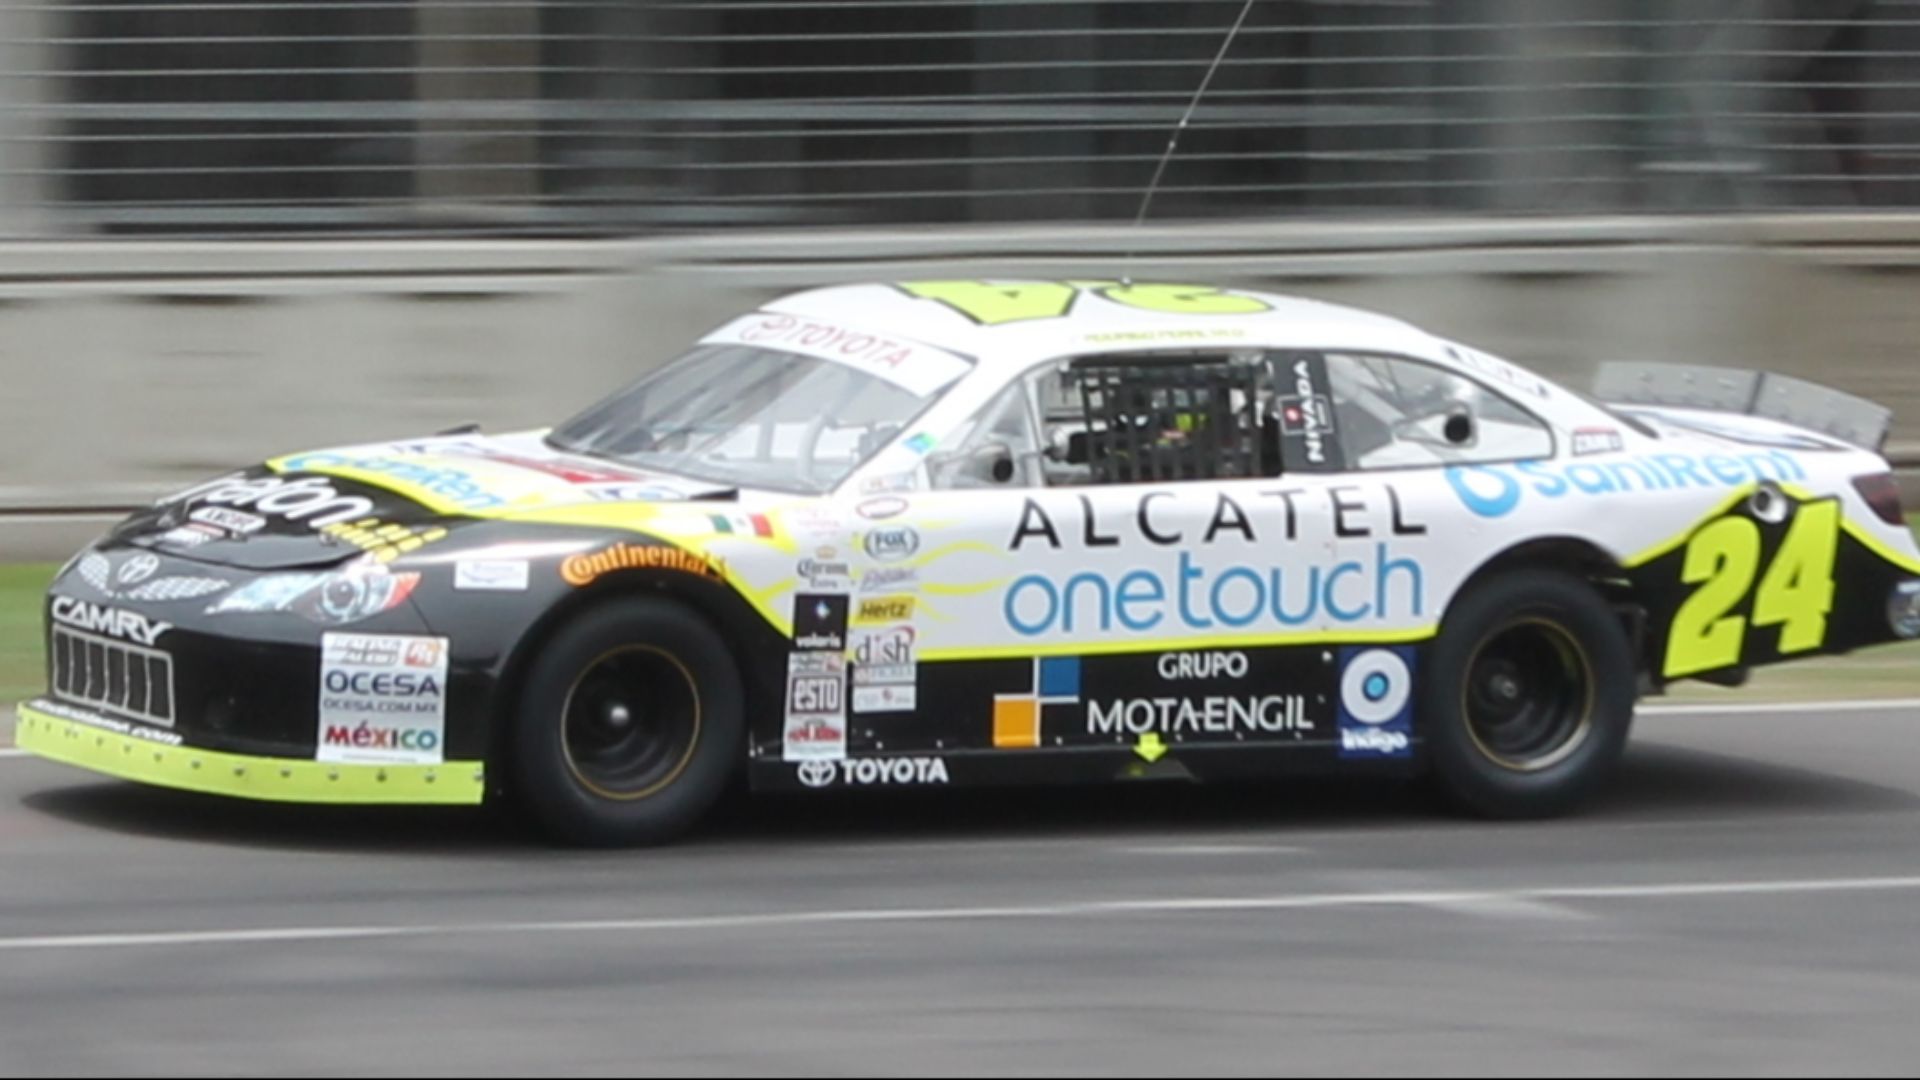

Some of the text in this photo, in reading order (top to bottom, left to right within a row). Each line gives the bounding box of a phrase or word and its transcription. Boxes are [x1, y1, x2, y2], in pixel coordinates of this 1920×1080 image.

[784, 321, 912, 368] TOYOTA
[1293, 359, 1325, 462] NIVADA
[1514, 449, 1808, 498] SaniRent
[1009, 485, 1427, 549] ALCATEL
[560, 541, 716, 586] Continental
[858, 602, 908, 617] Hertz
[1003, 541, 1424, 636] onetouch
[1662, 498, 1840, 678] 24
[51, 595, 174, 646] CAMRY
[855, 633, 911, 664] dish
[1157, 650, 1249, 680] GRUPO
[325, 669, 440, 697] OCESA
[840, 757, 949, 784] TOYOTA
